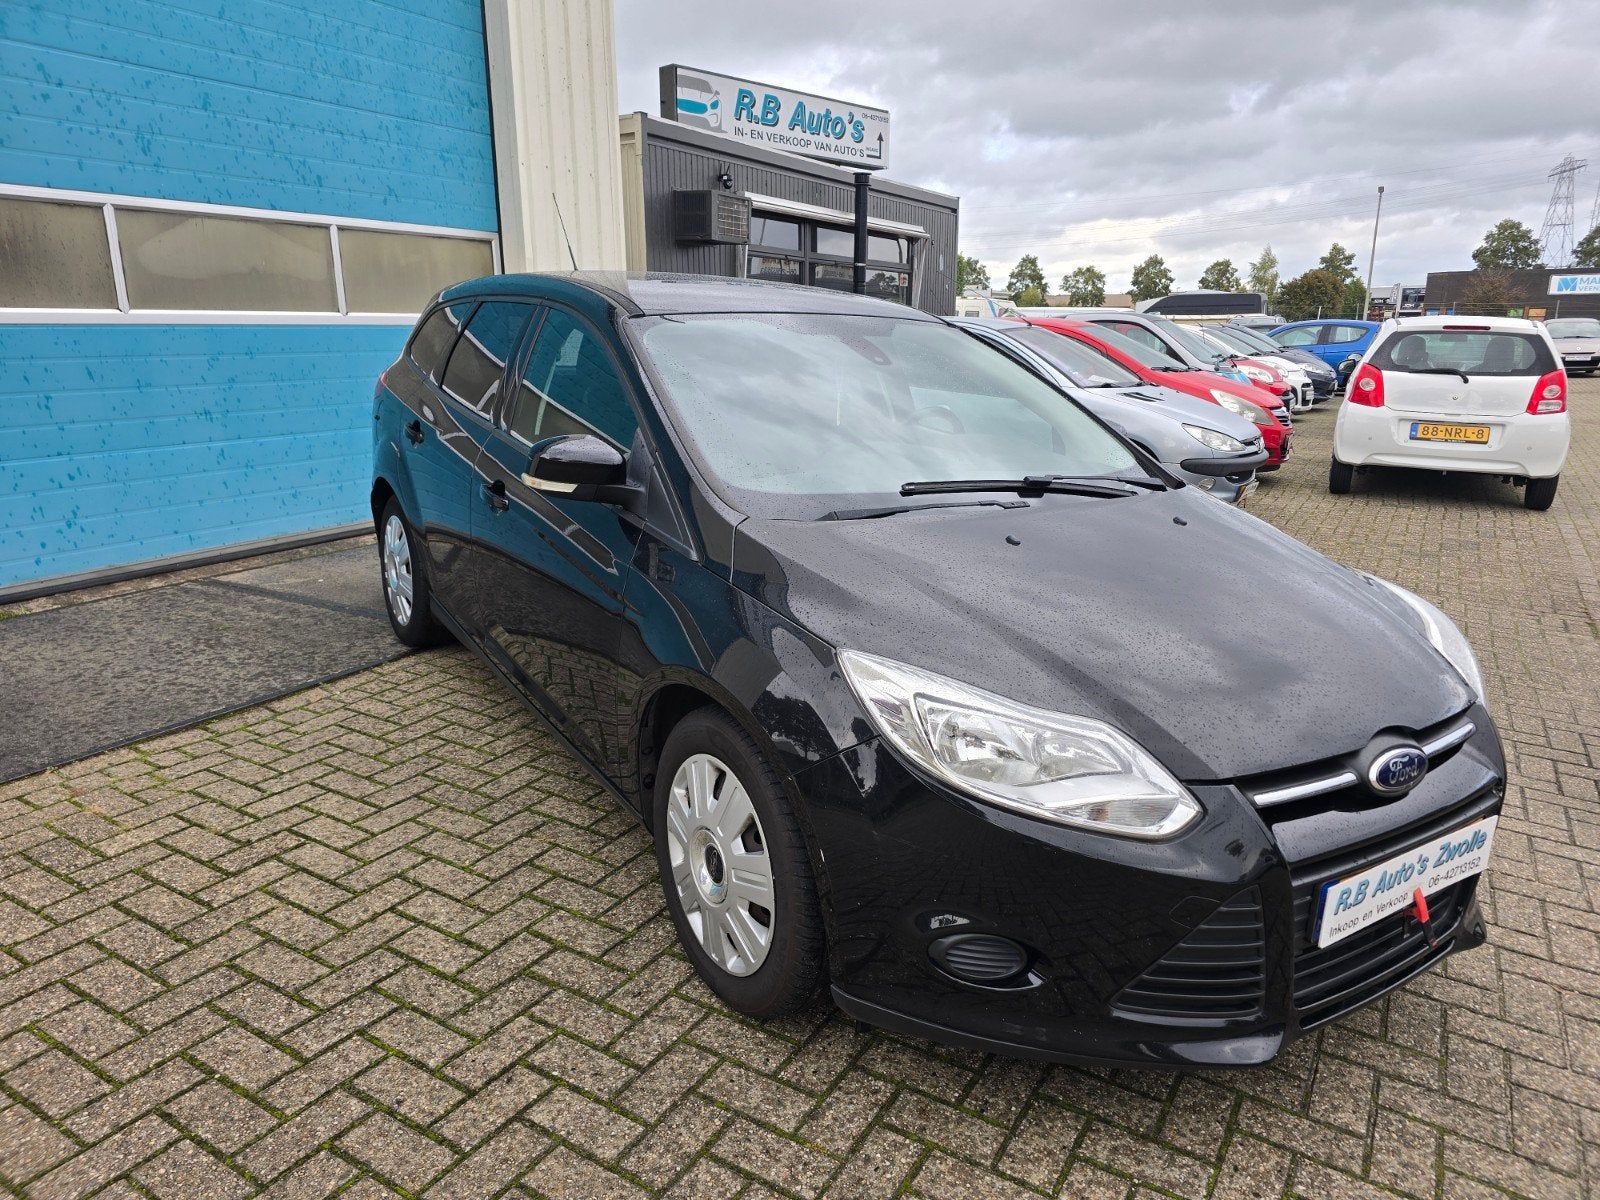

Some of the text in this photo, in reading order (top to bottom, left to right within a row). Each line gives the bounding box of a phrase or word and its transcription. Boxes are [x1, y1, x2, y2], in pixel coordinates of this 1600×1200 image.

[733, 88, 865, 143] R.B Auto's
[734, 126, 748, 137] IN-
[750, 129, 764, 141] EN
[765, 131, 812, 148] VERKOOP
[813, 141, 832, 153] VAN
[833, 143, 865, 158] AUTO'S
[1422, 426, 1485, 439] 88-NRL-8
[1389, 755, 1420, 785] Ford
[1333, 829, 1488, 916] R.B Auto's Zwolle
[1329, 856, 1481, 939] Inkoop en Verkoop 06-42713152
